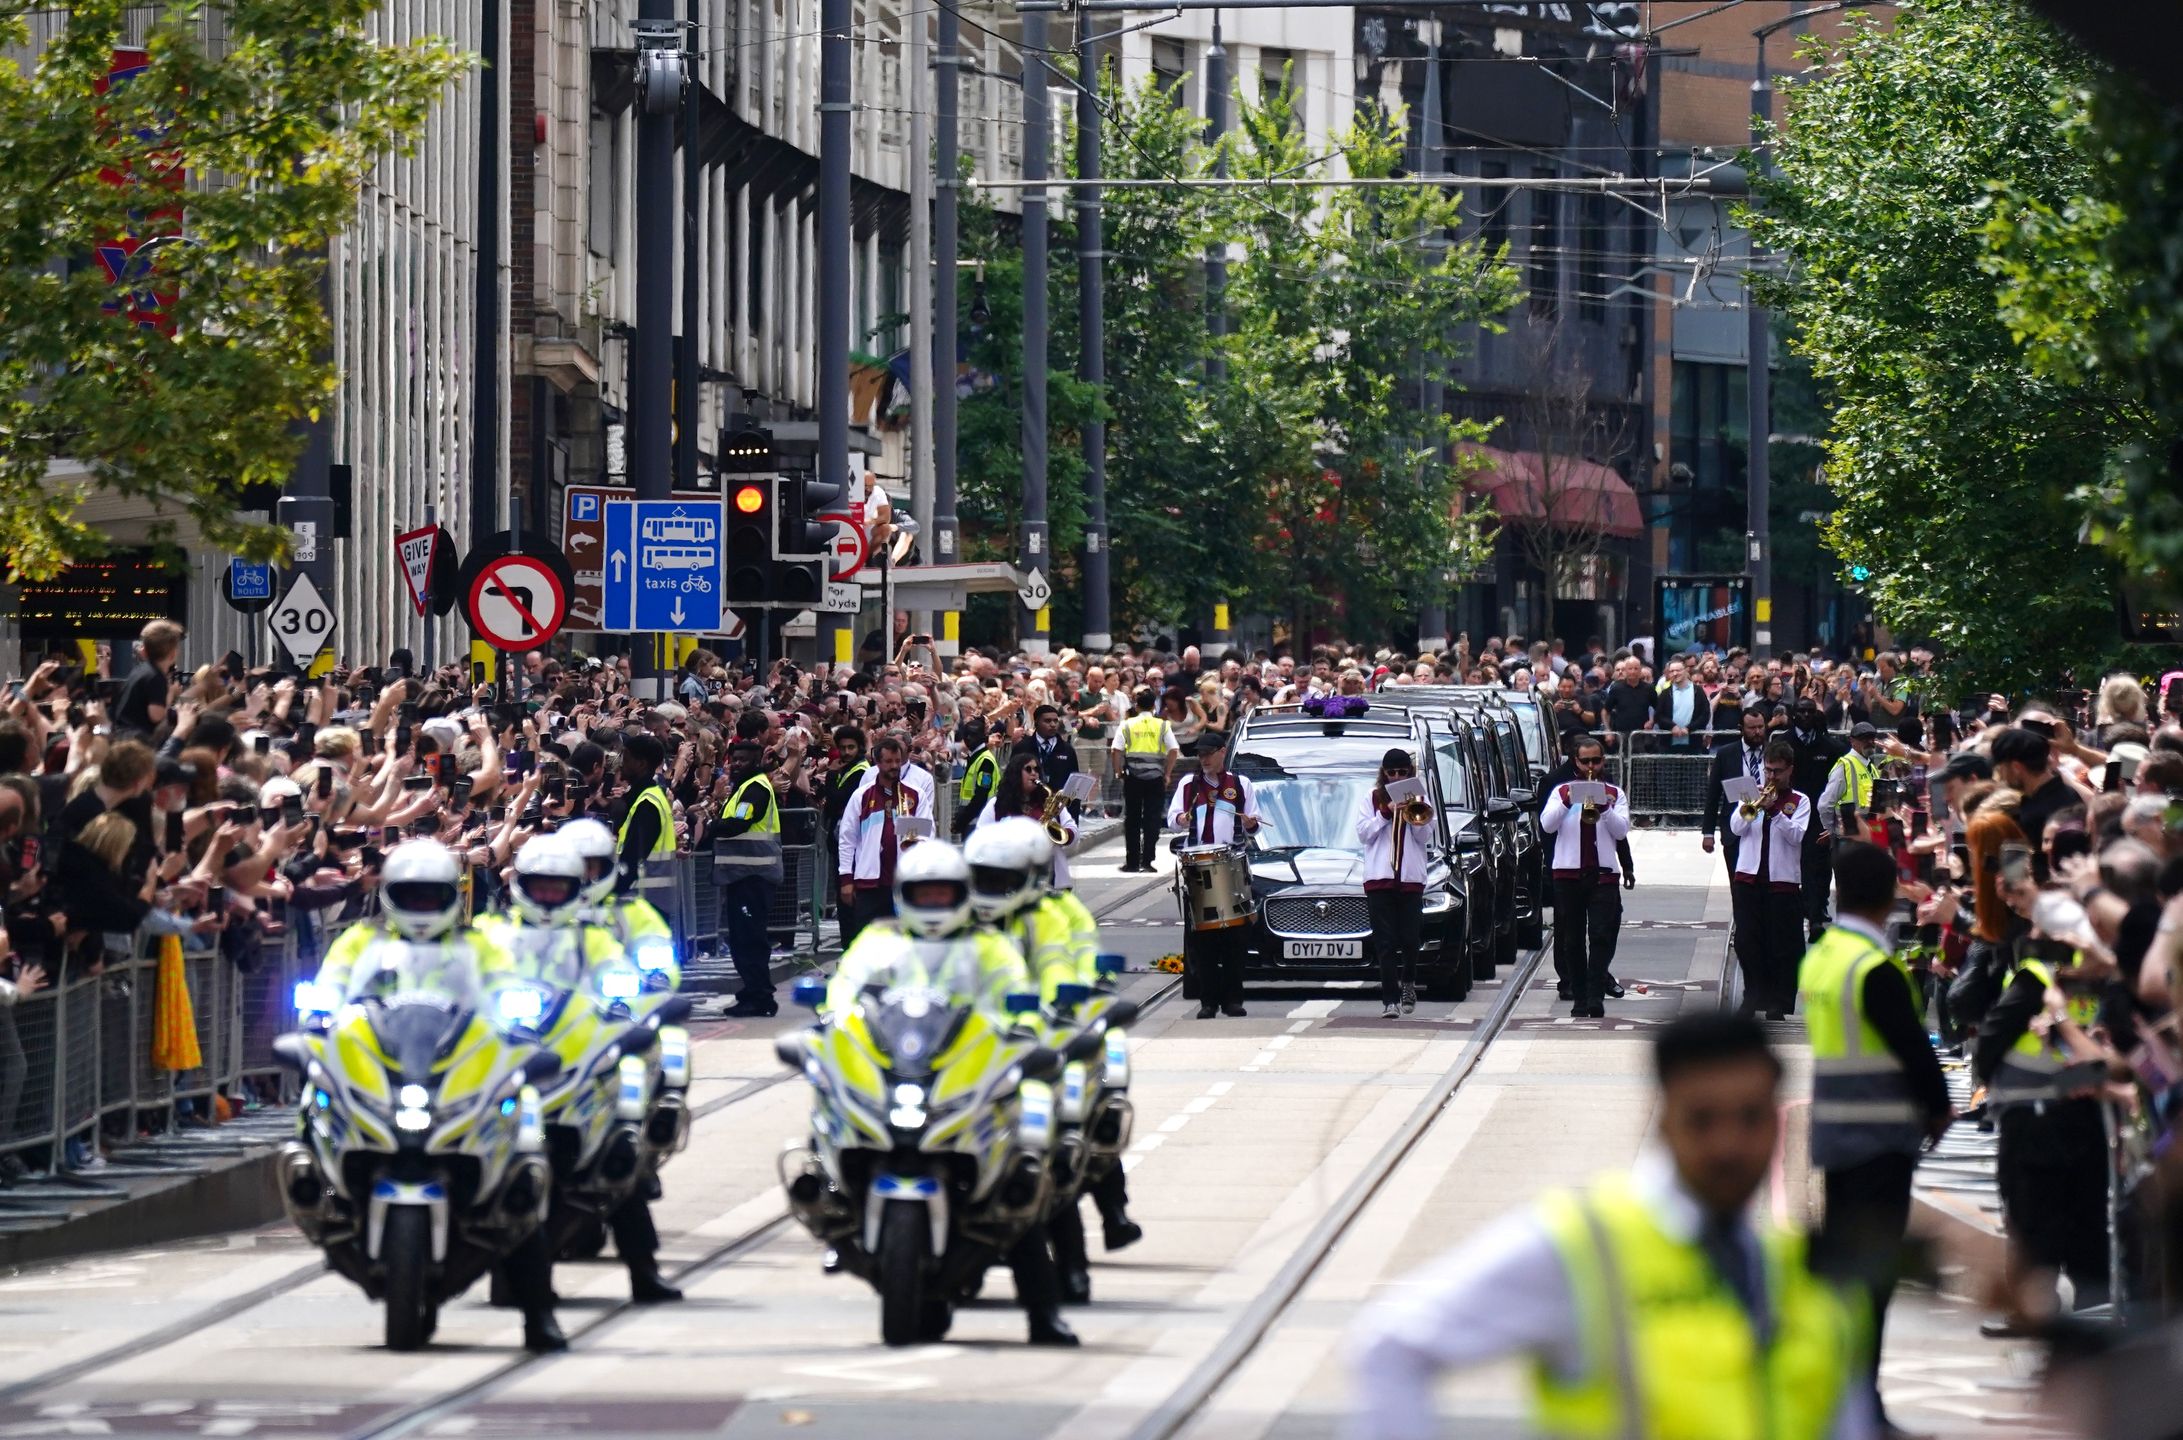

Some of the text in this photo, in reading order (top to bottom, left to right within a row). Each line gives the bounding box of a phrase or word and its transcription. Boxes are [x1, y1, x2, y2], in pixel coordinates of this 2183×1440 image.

[577, 497, 596, 519] P
[404, 540, 429, 561] GIVE
[411, 562, 427, 577] WAY
[645, 577, 677, 589] taxis
[1023, 584, 1047, 599] 30
[838, 599, 857, 609] yds
[281, 608, 326, 635] 30
[1292, 943, 1354, 957] OY17 DVJ
